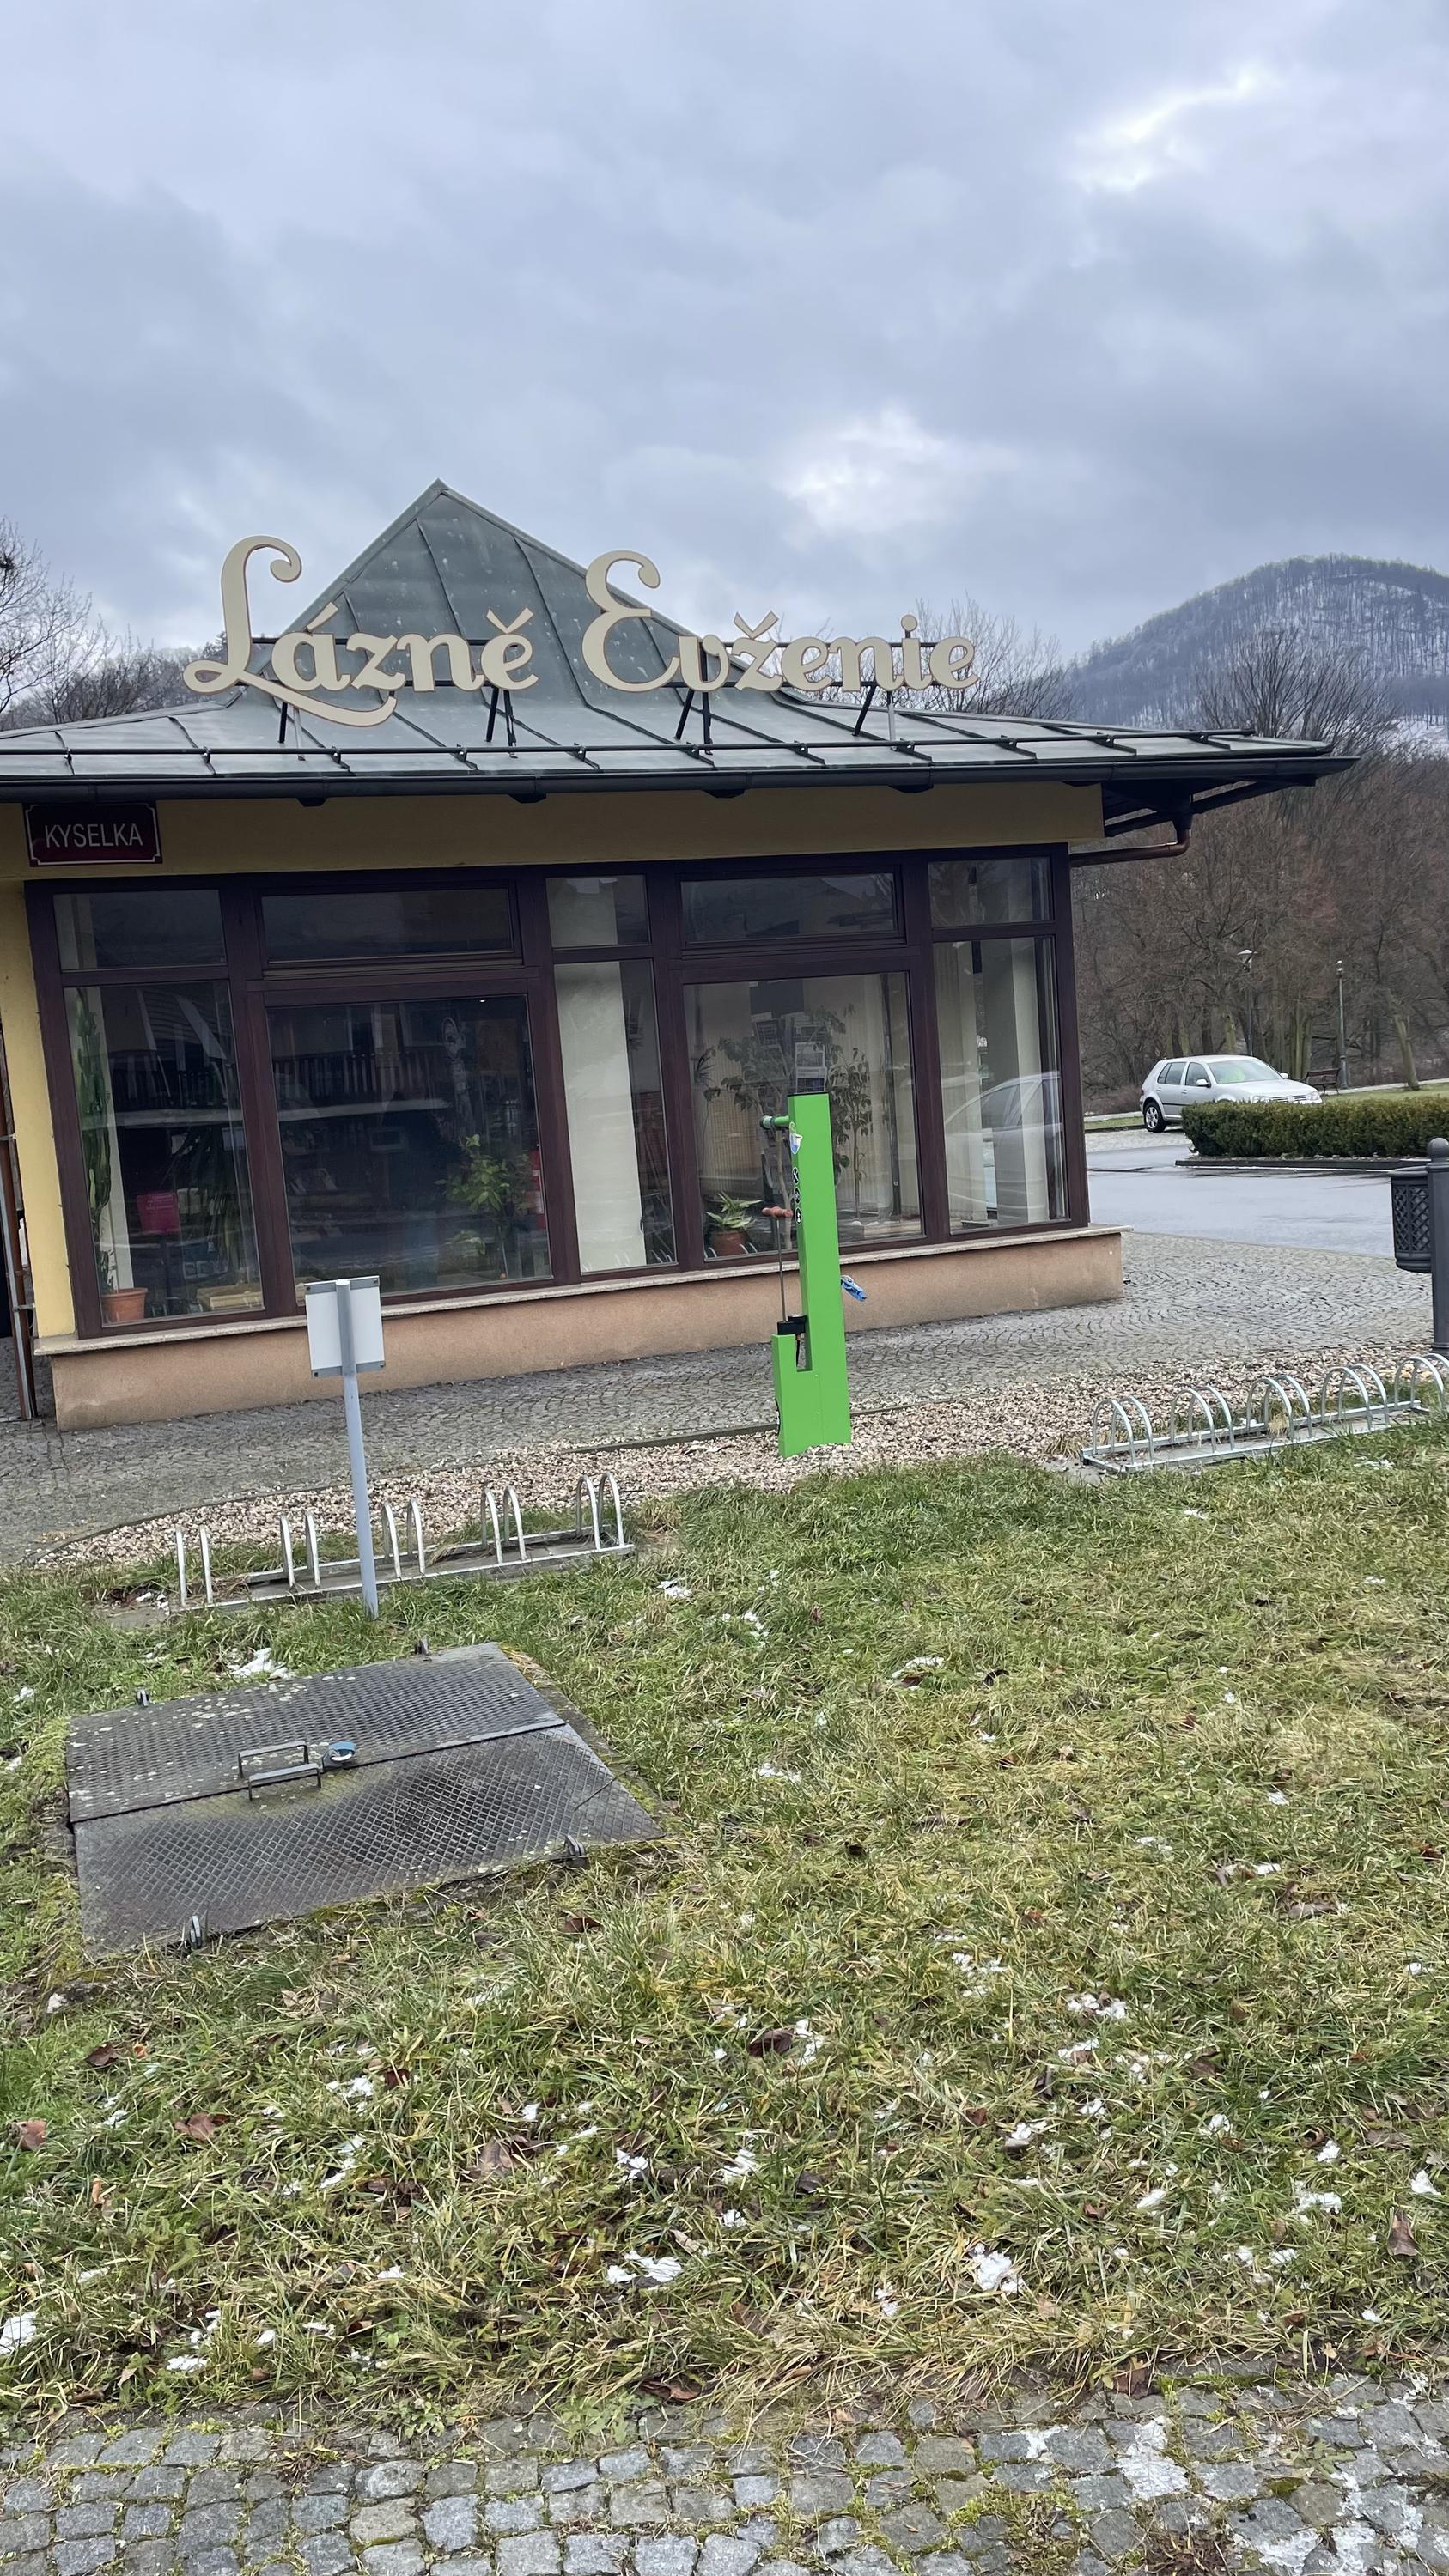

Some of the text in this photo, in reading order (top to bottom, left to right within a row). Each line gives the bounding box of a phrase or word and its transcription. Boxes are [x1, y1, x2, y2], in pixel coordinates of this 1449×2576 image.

[183, 535, 981, 727] Lázně Evženie
[44, 823, 143, 848] KYSELKA
